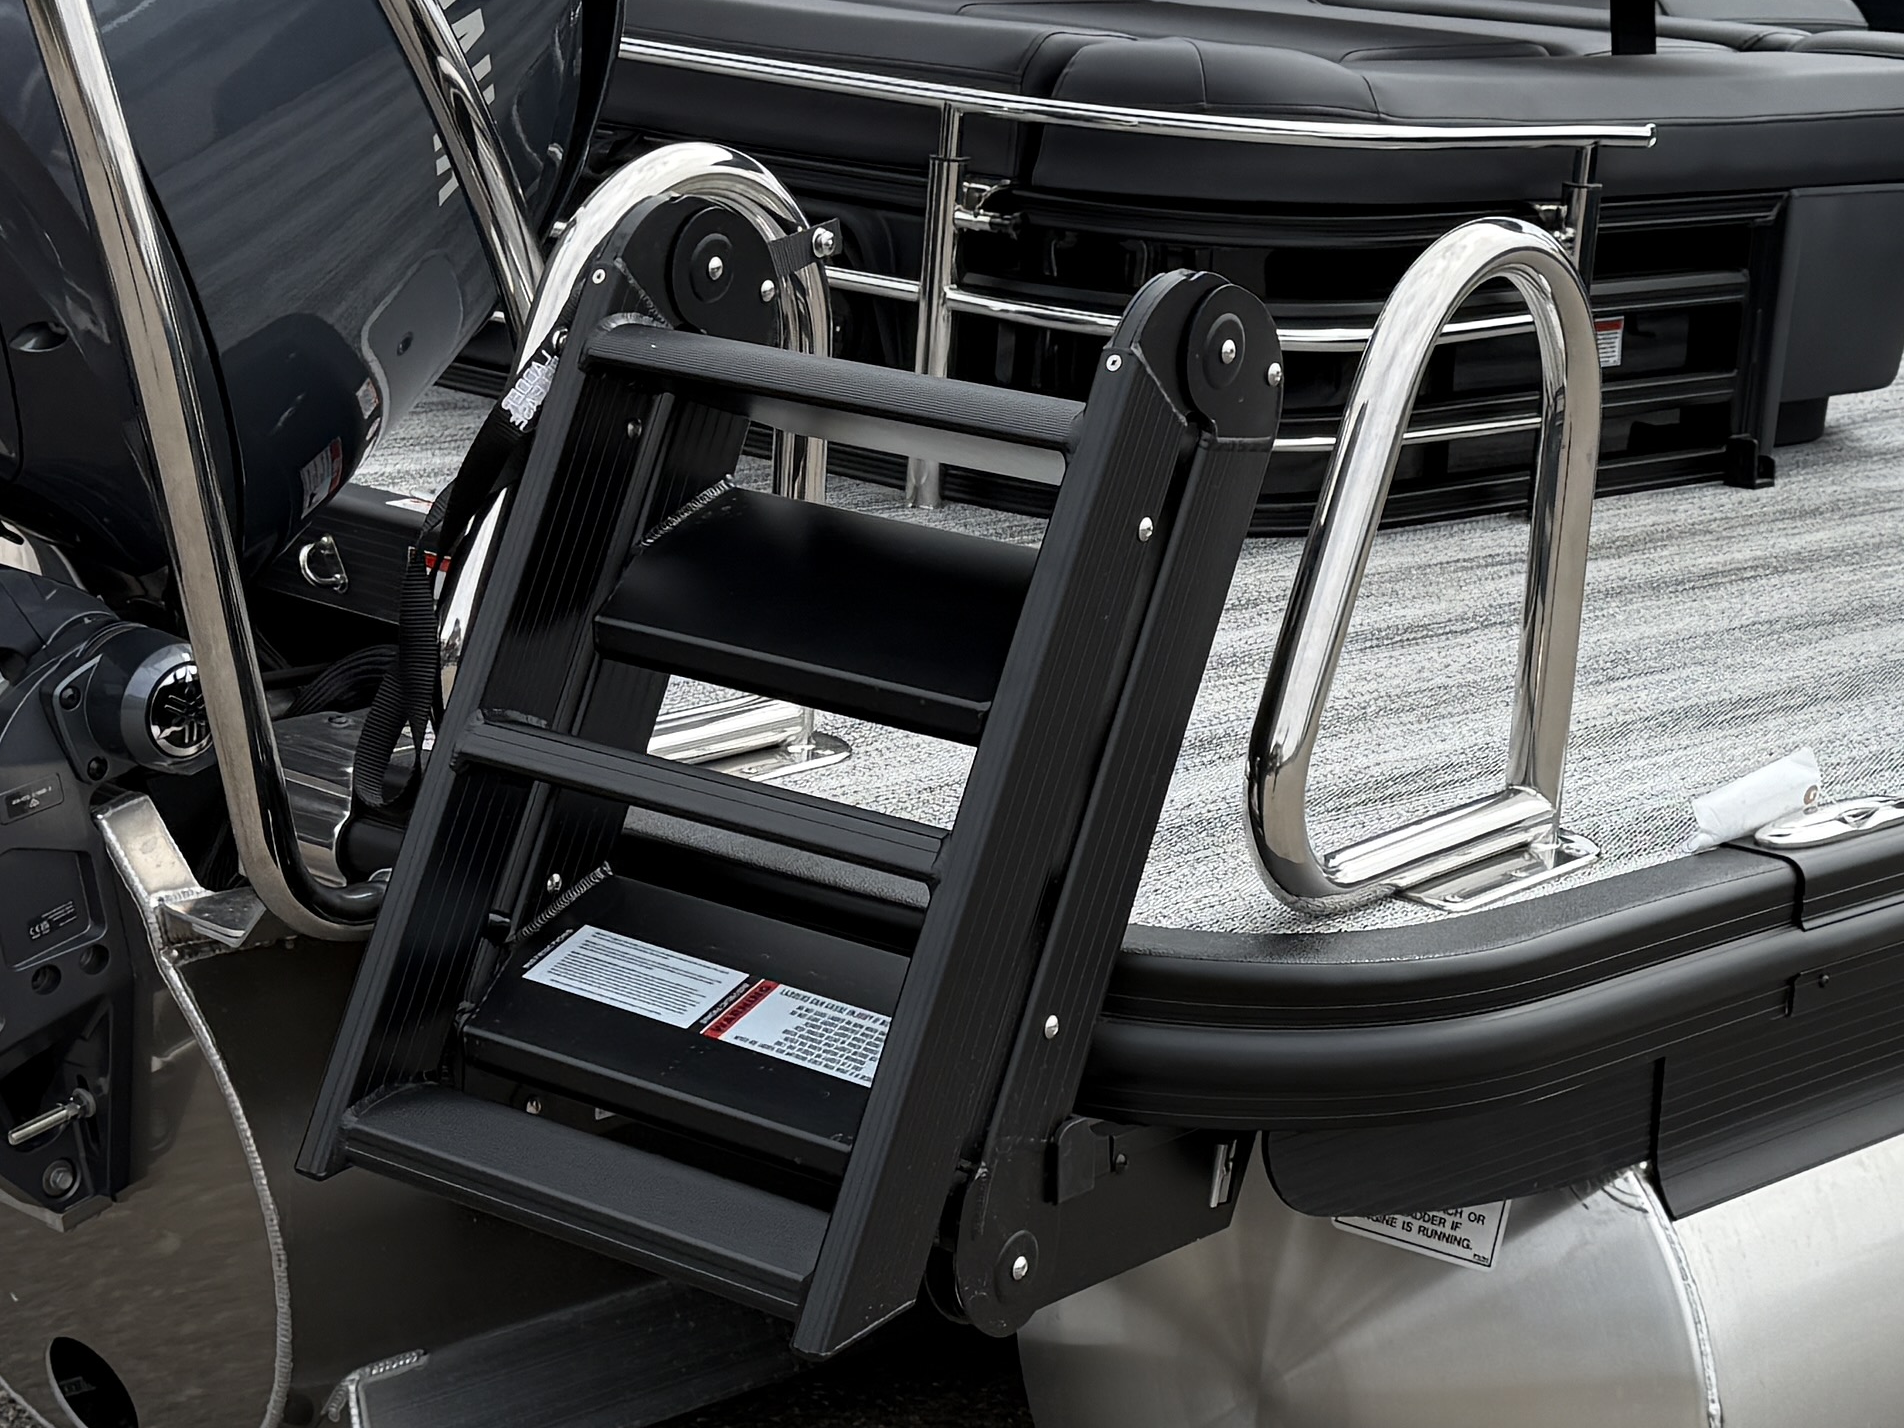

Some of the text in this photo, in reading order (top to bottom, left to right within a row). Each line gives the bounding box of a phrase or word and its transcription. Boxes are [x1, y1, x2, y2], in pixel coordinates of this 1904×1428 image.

[710, 985, 772, 1032] WARNING
[1411, 1211, 1447, 1229] DDER
[1450, 1220, 1463, 1232] IF
[1467, 1211, 1486, 1226] OR
[1401, 1220, 1414, 1233] IS
[1417, 1224, 1473, 1251] RUNNING.
